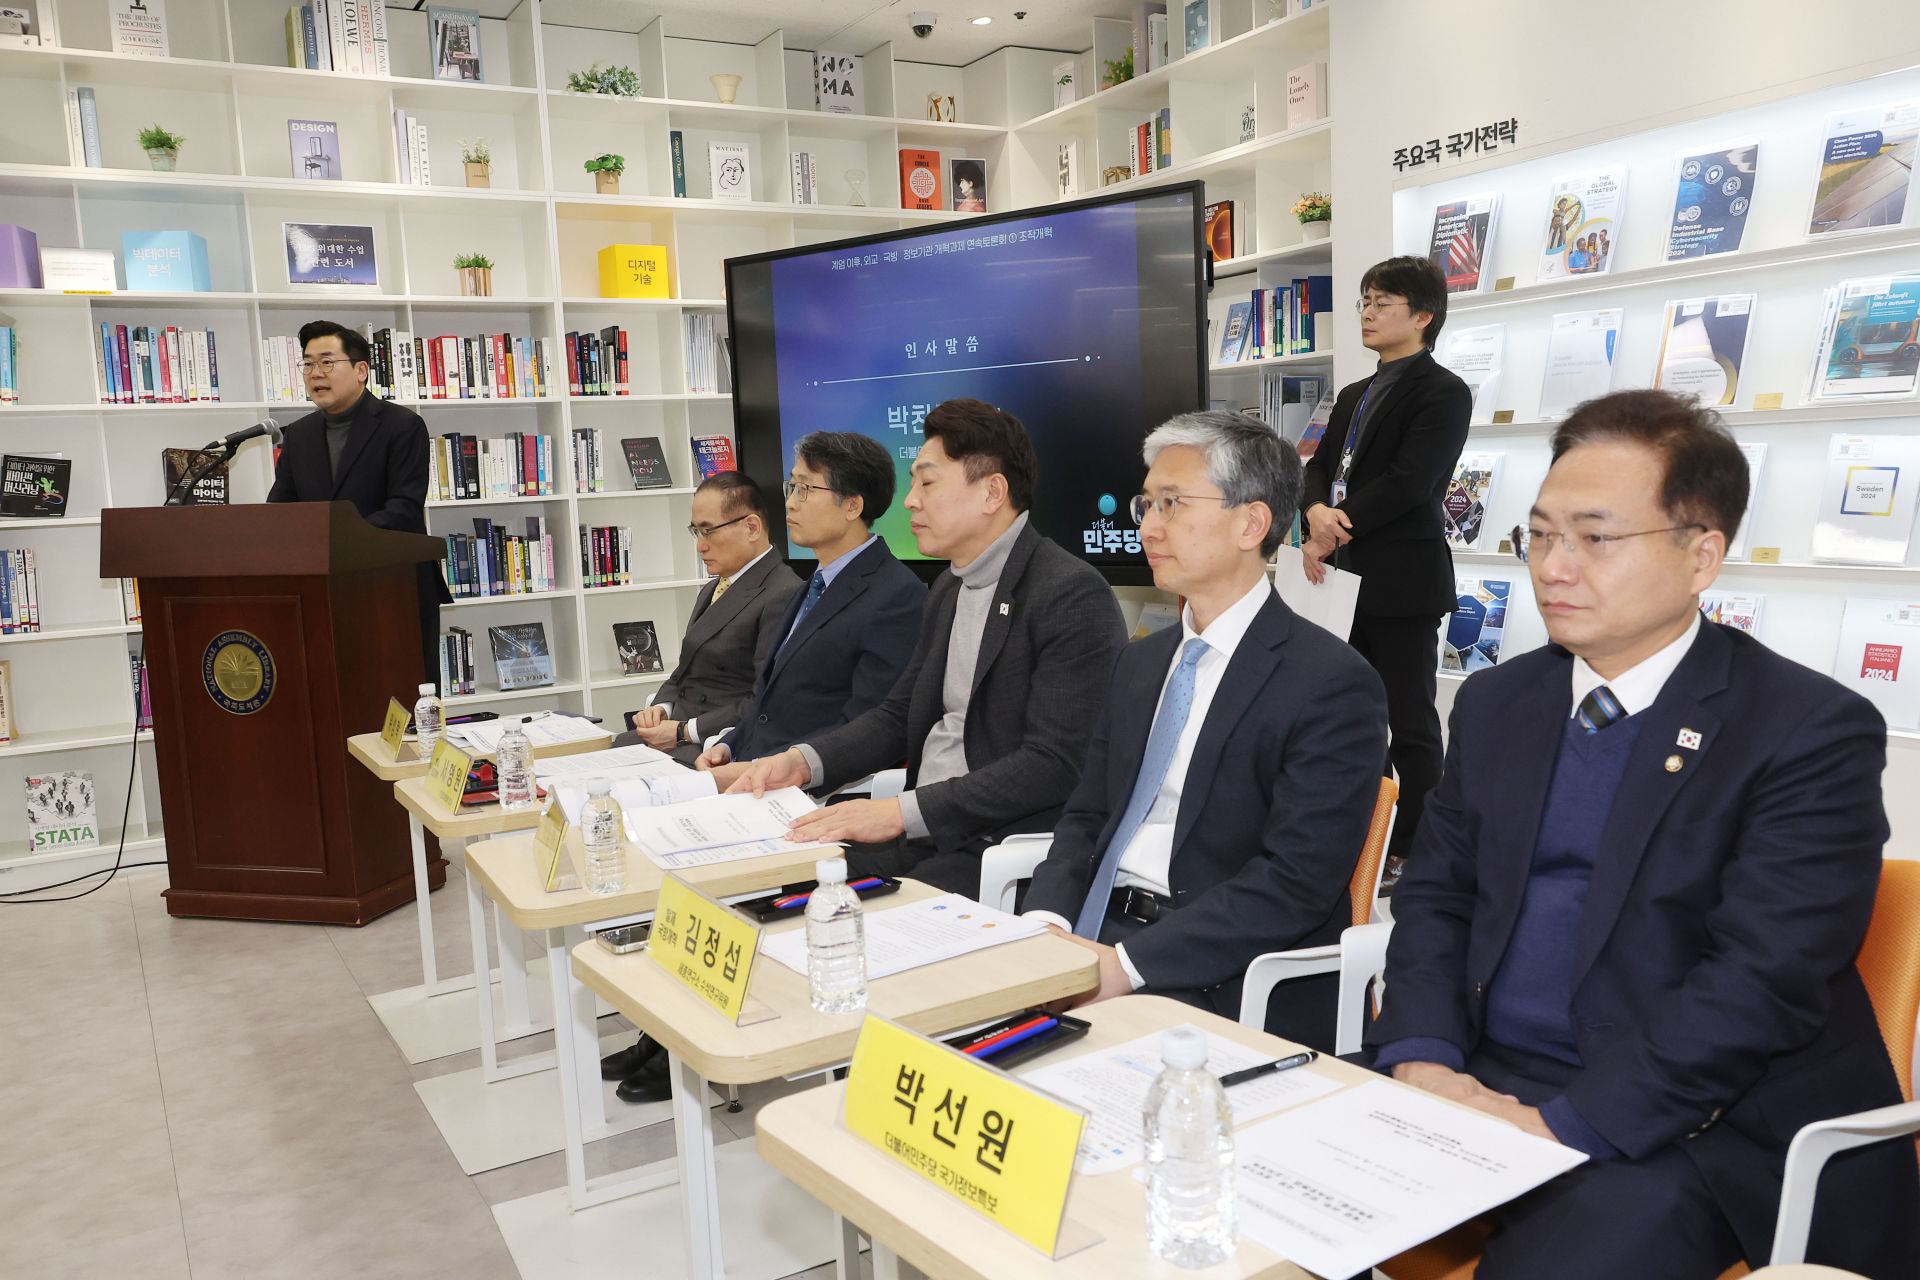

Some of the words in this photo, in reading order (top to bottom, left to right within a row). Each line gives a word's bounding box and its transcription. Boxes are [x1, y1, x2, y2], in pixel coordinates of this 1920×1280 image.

[344, 1, 359, 47] LOEWE
[1289, 75, 1301, 84] The
[1289, 82, 1310, 95] Lonely
[291, 122, 335, 134] DESIGN
[1393, 139, 1442, 172] 주요국
[1446, 118, 1518, 158] 국가전략
[1586, 186, 1618, 195] STRATEGY
[1439, 214, 1470, 224] Increasing
[1437, 221, 1467, 232] American
[1436, 228, 1469, 240] Diplomatic
[1671, 233, 1719, 244] Cybersecurity
[1672, 229, 1706, 238] Industrial
[831, 259, 846, 270] 계엄
[863, 254, 879, 266] 외교
[883, 251, 898, 263] 국방
[903, 247, 933, 261] 정보기관
[934, 243, 965, 256] 개혁과제
[966, 234, 1007, 251] 연속토론회
[1018, 227, 1053, 242] 조직개혁
[1435, 238, 1454, 247] Power
[132, 248, 182, 261] 빅데이터
[318, 244, 344, 254] 위대한
[347, 245, 364, 255] 수업
[334, 258, 354, 268] 도서
[627, 259, 656, 272] 디지털
[633, 273, 653, 286] 기술
[6, 470, 33, 483] 파이썬
[4, 481, 39, 495] 머신러닝
[193, 489, 224, 498] 마이닝
[1450, 495, 1467, 503] 2024
[1083, 529, 1142, 554] 민주당
[1864, 667, 1895, 680] 2024
[34, 826, 95, 846] STATA
[685, 914, 741, 983] 김정섭
[894, 1064, 1014, 1175] 박선원
[885, 1131, 938, 1177] 더불어민주당
[939, 1166, 999, 1215] 국가정보특보
